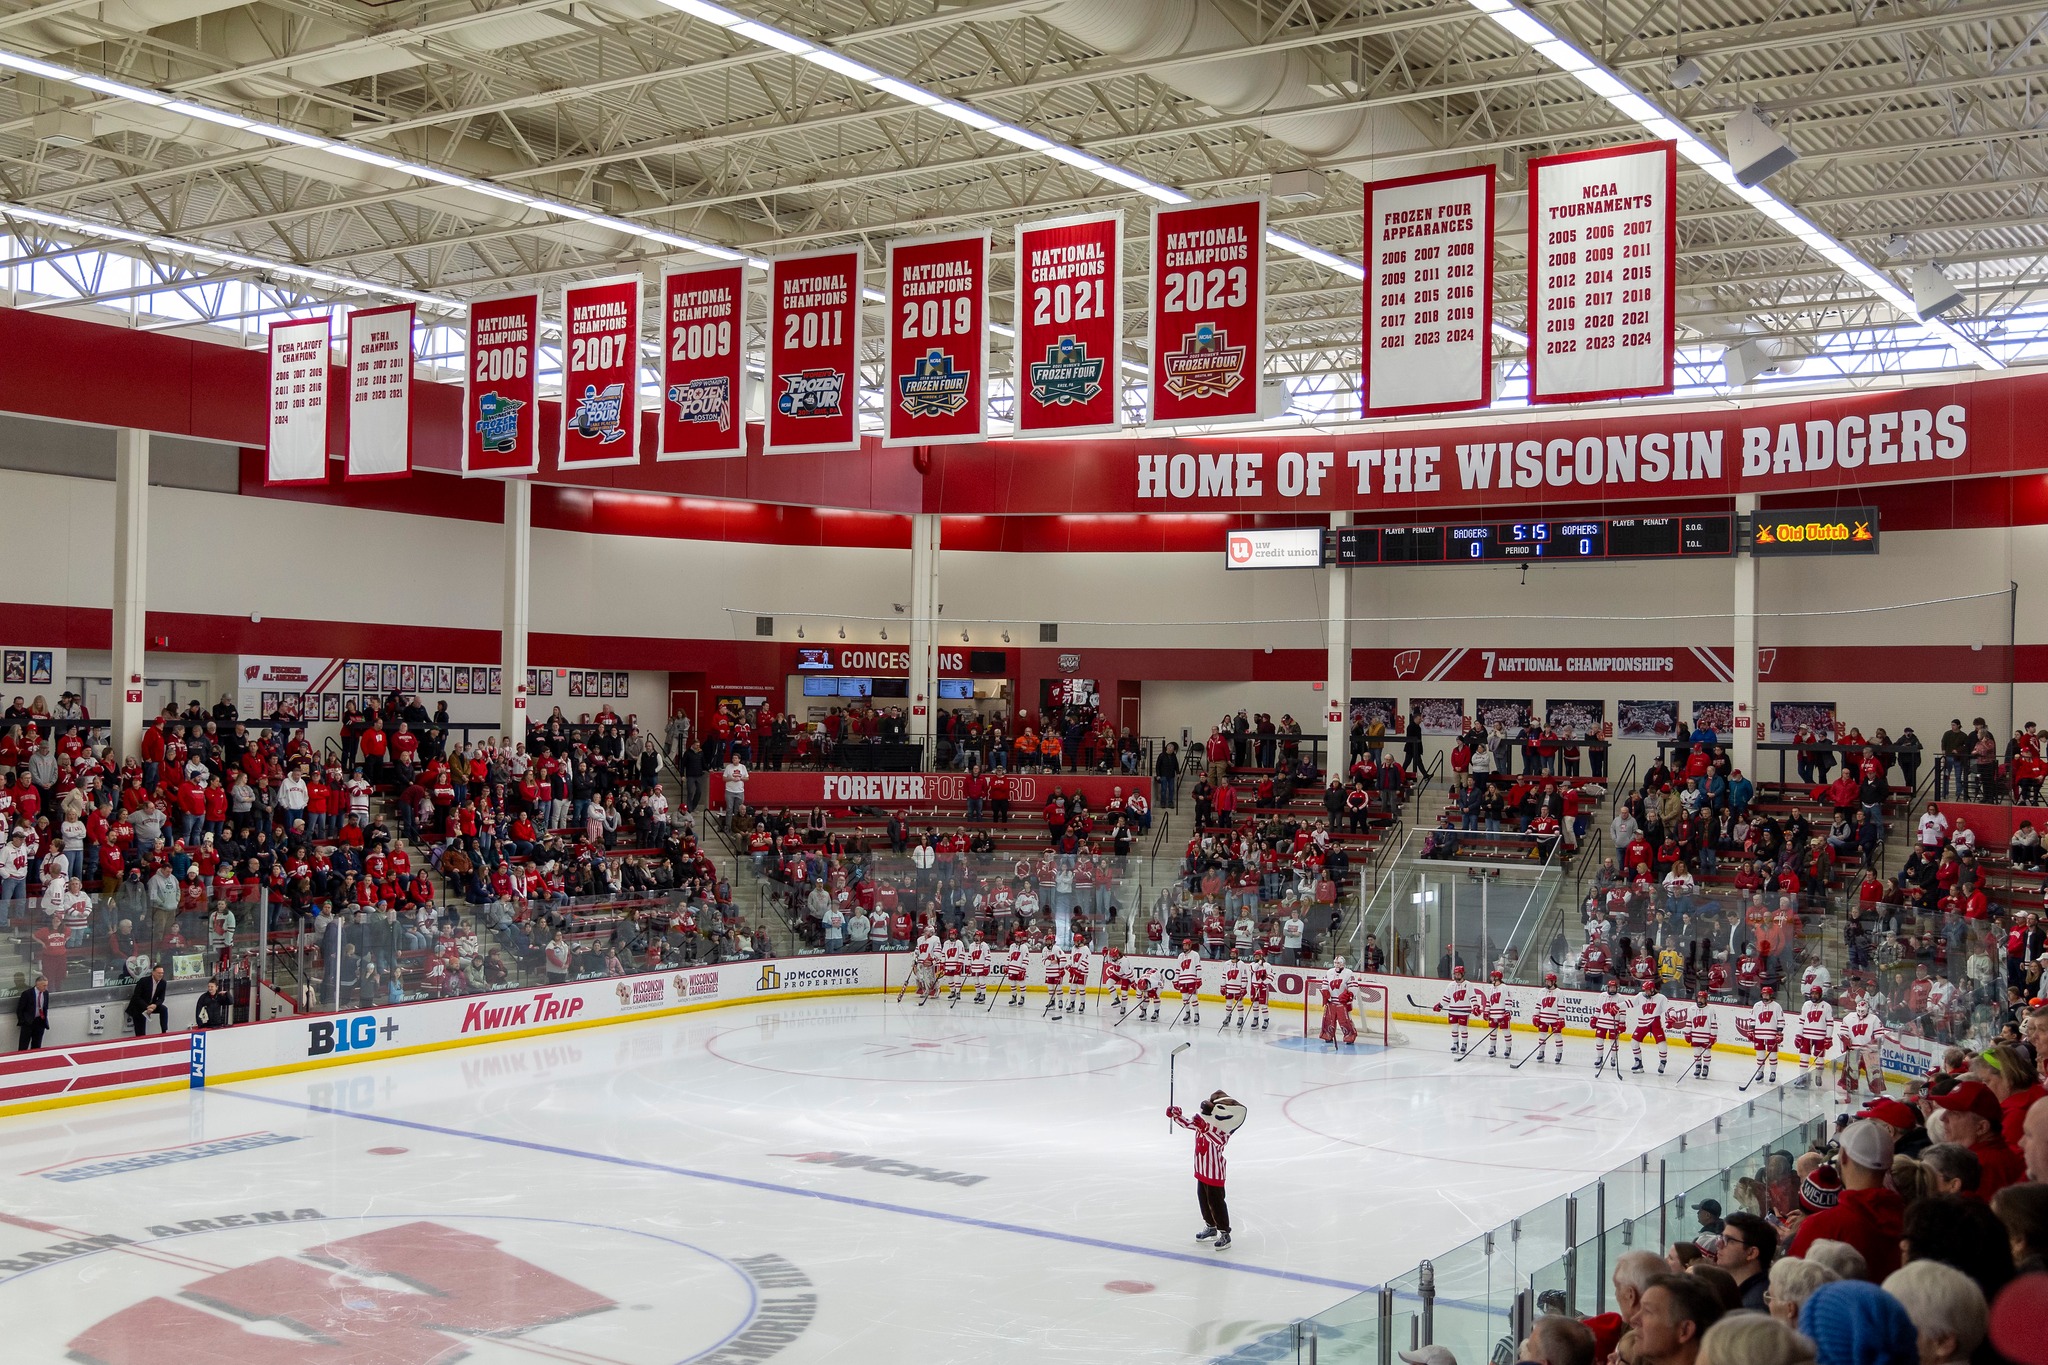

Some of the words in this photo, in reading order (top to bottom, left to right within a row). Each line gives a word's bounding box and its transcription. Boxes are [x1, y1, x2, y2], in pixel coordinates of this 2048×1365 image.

[1583, 183, 1617, 199] NCAA
[1385, 208, 1432, 225] FROZEN
[1438, 203, 1471, 218] FOUR
[1549, 195, 1652, 219] TOURNAMENTS
[1167, 226, 1247, 250] NATIONAL
[1383, 218, 1473, 241] APPEARANCES
[1549, 230, 1576, 245] 2005
[1586, 225, 1614, 240] 2006
[1624, 220, 1652, 236] 2007
[1032, 243, 1104, 267] NATIONAL
[1166, 244, 1248, 267] CHAMPIONS
[1382, 251, 1406, 265] 2006
[1415, 247, 1440, 260] 2007
[1448, 243, 1474, 257] 2008
[1549, 252, 1576, 267] 2008
[1586, 247, 1613, 262] 2009
[1623, 243, 1650, 258] 2011
[903, 260, 972, 281] NATIONAL
[1032, 260, 1104, 283] CHAMPIONS
[1382, 272, 1405, 285] 2009
[1415, 268, 1439, 282] 2011
[1447, 264, 1473, 278] 2012
[1549, 274, 1576, 289] 2012
[1586, 270, 1612, 284] 2014
[1623, 266, 1651, 281] 2015
[784, 275, 847, 294] NATIONAL
[903, 278, 972, 297] CHAMPIONS
[1164, 266, 1247, 312] 2023
[673, 288, 731, 308] NATIONAL
[784, 291, 847, 310] CHAMPIONS
[1034, 280, 1104, 326] 2021
[1382, 293, 1405, 306] 2014
[1415, 289, 1439, 303] 2015
[1447, 286, 1473, 299] 2016
[1548, 296, 1575, 311] 2016
[1586, 292, 1612, 306] 2017
[1623, 288, 1651, 303] 2018
[574, 302, 627, 321] NATIONAL
[673, 303, 731, 322] CHAMPIONS
[902, 297, 971, 339] 2019
[1381, 314, 1405, 327] 2017
[1415, 310, 1439, 324] 2018
[1447, 307, 1474, 321] 2019
[477, 314, 527, 332] NATIONAL
[574, 316, 626, 334] CHAMPIONS
[784, 310, 842, 349] 2011
[1547, 318, 1575, 332] 2019
[1585, 314, 1614, 328] 2020
[1622, 311, 1649, 325] 2021
[371, 331, 389, 342] WCHA
[477, 330, 528, 346] CHAMPIONS
[672, 320, 731, 361] 2009
[1381, 335, 1404, 348] 2021
[1415, 332, 1439, 345] 2023
[1447, 329, 1474, 342] 2024
[1547, 340, 1576, 354] 2022
[1586, 336, 1615, 350] 2023
[1622, 332, 1651, 347] 2024
[277, 343, 295, 353] WCHA
[297, 340, 322, 351] PLAYOFF
[361, 341, 398, 353] CHAMPIONS
[572, 334, 626, 372] 2007
[282, 351, 316, 363] CHAMPIONS
[476, 346, 527, 382] 2006
[1173, 359, 1210, 371] FROZEN
[1211, 356, 1237, 368] FOUR
[1037, 368, 1071, 380] FROZEN
[1073, 366, 1095, 378] FOUR
[677, 386, 724, 401] FROZEN
[787, 376, 841, 393] FROZEN
[906, 381, 939, 392] FROZEN
[940, 379, 963, 390] FOUR
[586, 400, 620, 412] FROZEN
[680, 398, 722, 419] FOUR
[476, 415, 517, 432] FROZEN
[586, 409, 618, 426] FOUR
[487, 422, 516, 438] FOUR
[1137, 452, 1263, 499] HOME
[1277, 452, 1334, 497] OF
[1347, 446, 1441, 494] THE
[1455, 430, 1724, 490] WISCONSIN
[1741, 404, 1967, 478] BADGERS
[1454, 529, 1487, 539] BADGERS
[1514, 524, 1545, 540] 5:15
[1562, 525, 1597, 535] GOPHERS
[1776, 525, 1803, 542] Old
[1806, 522, 1850, 541] Dutch
[1255, 548, 1286, 558] credit
[1288, 548, 1318, 557] union
[1470, 543, 1480, 557] 0
[1506, 546, 1529, 554] PERIOD
[1536, 544, 1542, 556] 1
[1580, 540, 1589, 554] 0
[842, 651, 962, 670] CONCESNS
[1482, 652, 1495, 678] 7
[1499, 657, 1562, 672] NATIONAL
[1566, 657, 1674, 672] CHAMPIONSHIPS
[689, 972, 718, 986] WISCONSIN
[784, 972, 796, 980] JD
[799, 968, 858, 979] McCORMICK
[785, 978, 858, 988] PROPERTIES
[633, 979, 664, 994] WISCONSIN
[689, 984, 718, 996] CRANBERRIES
[633, 991, 663, 1004] CRANBERRIES
[461, 1000, 530, 1033] KWIK
[533, 993, 584, 1023] TRIP
[192, 1034, 204, 1077] CCM
[1907, 1054, 1930, 1067] FAILY
[145, 1208, 328, 1238] ARENA
